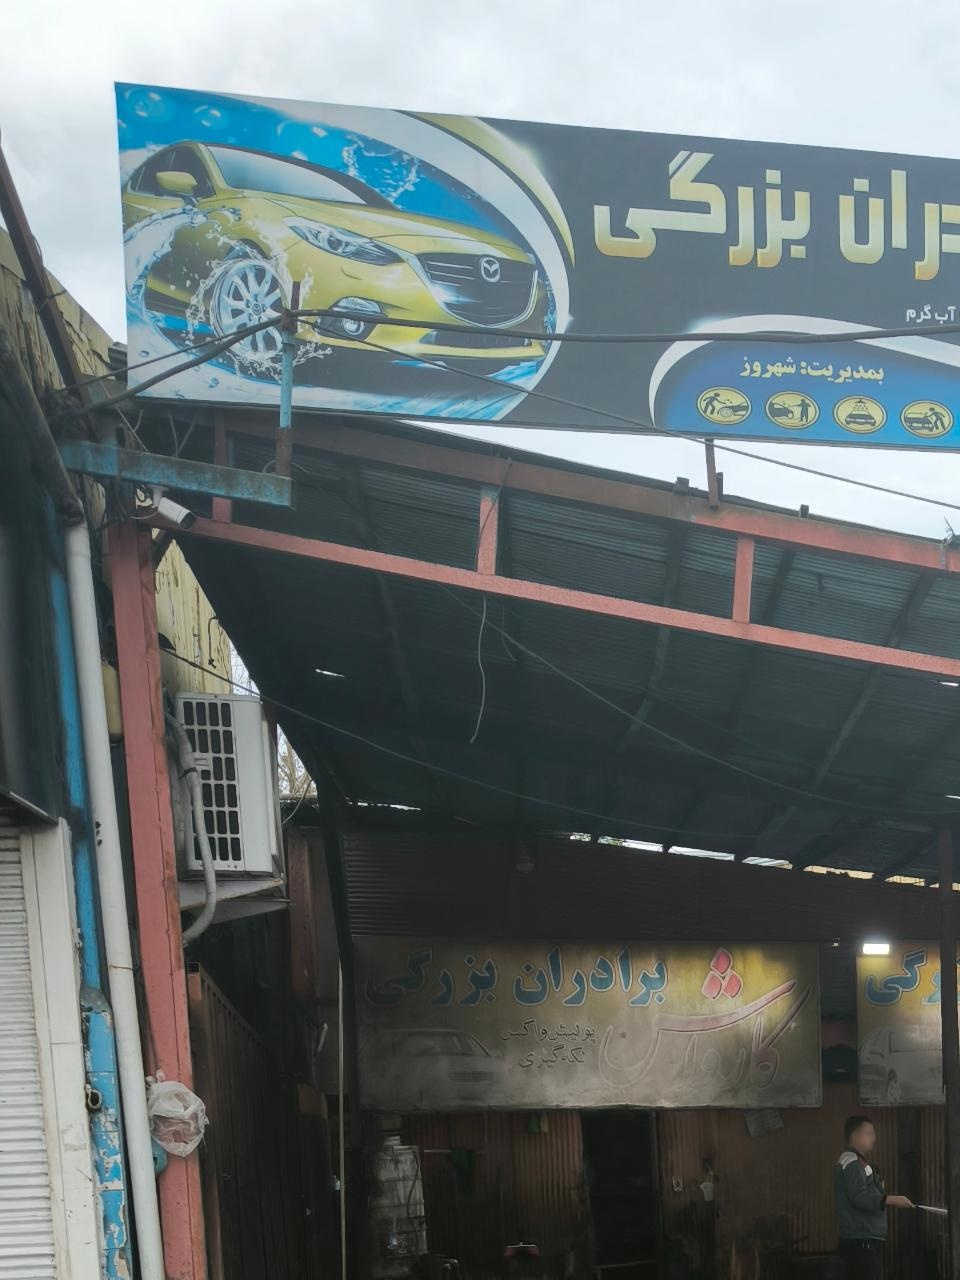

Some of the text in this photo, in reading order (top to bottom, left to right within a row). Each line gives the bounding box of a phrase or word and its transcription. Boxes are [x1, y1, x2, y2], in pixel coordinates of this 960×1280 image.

[593, 150, 811, 268] بزرگی
[906, 304, 931, 323] گرم
[934, 306, 956, 325] آب
[740, 356, 797, 378] شهروز
[365, 948, 498, 1007] بزرگی
[512, 946, 668, 1007] برادران
